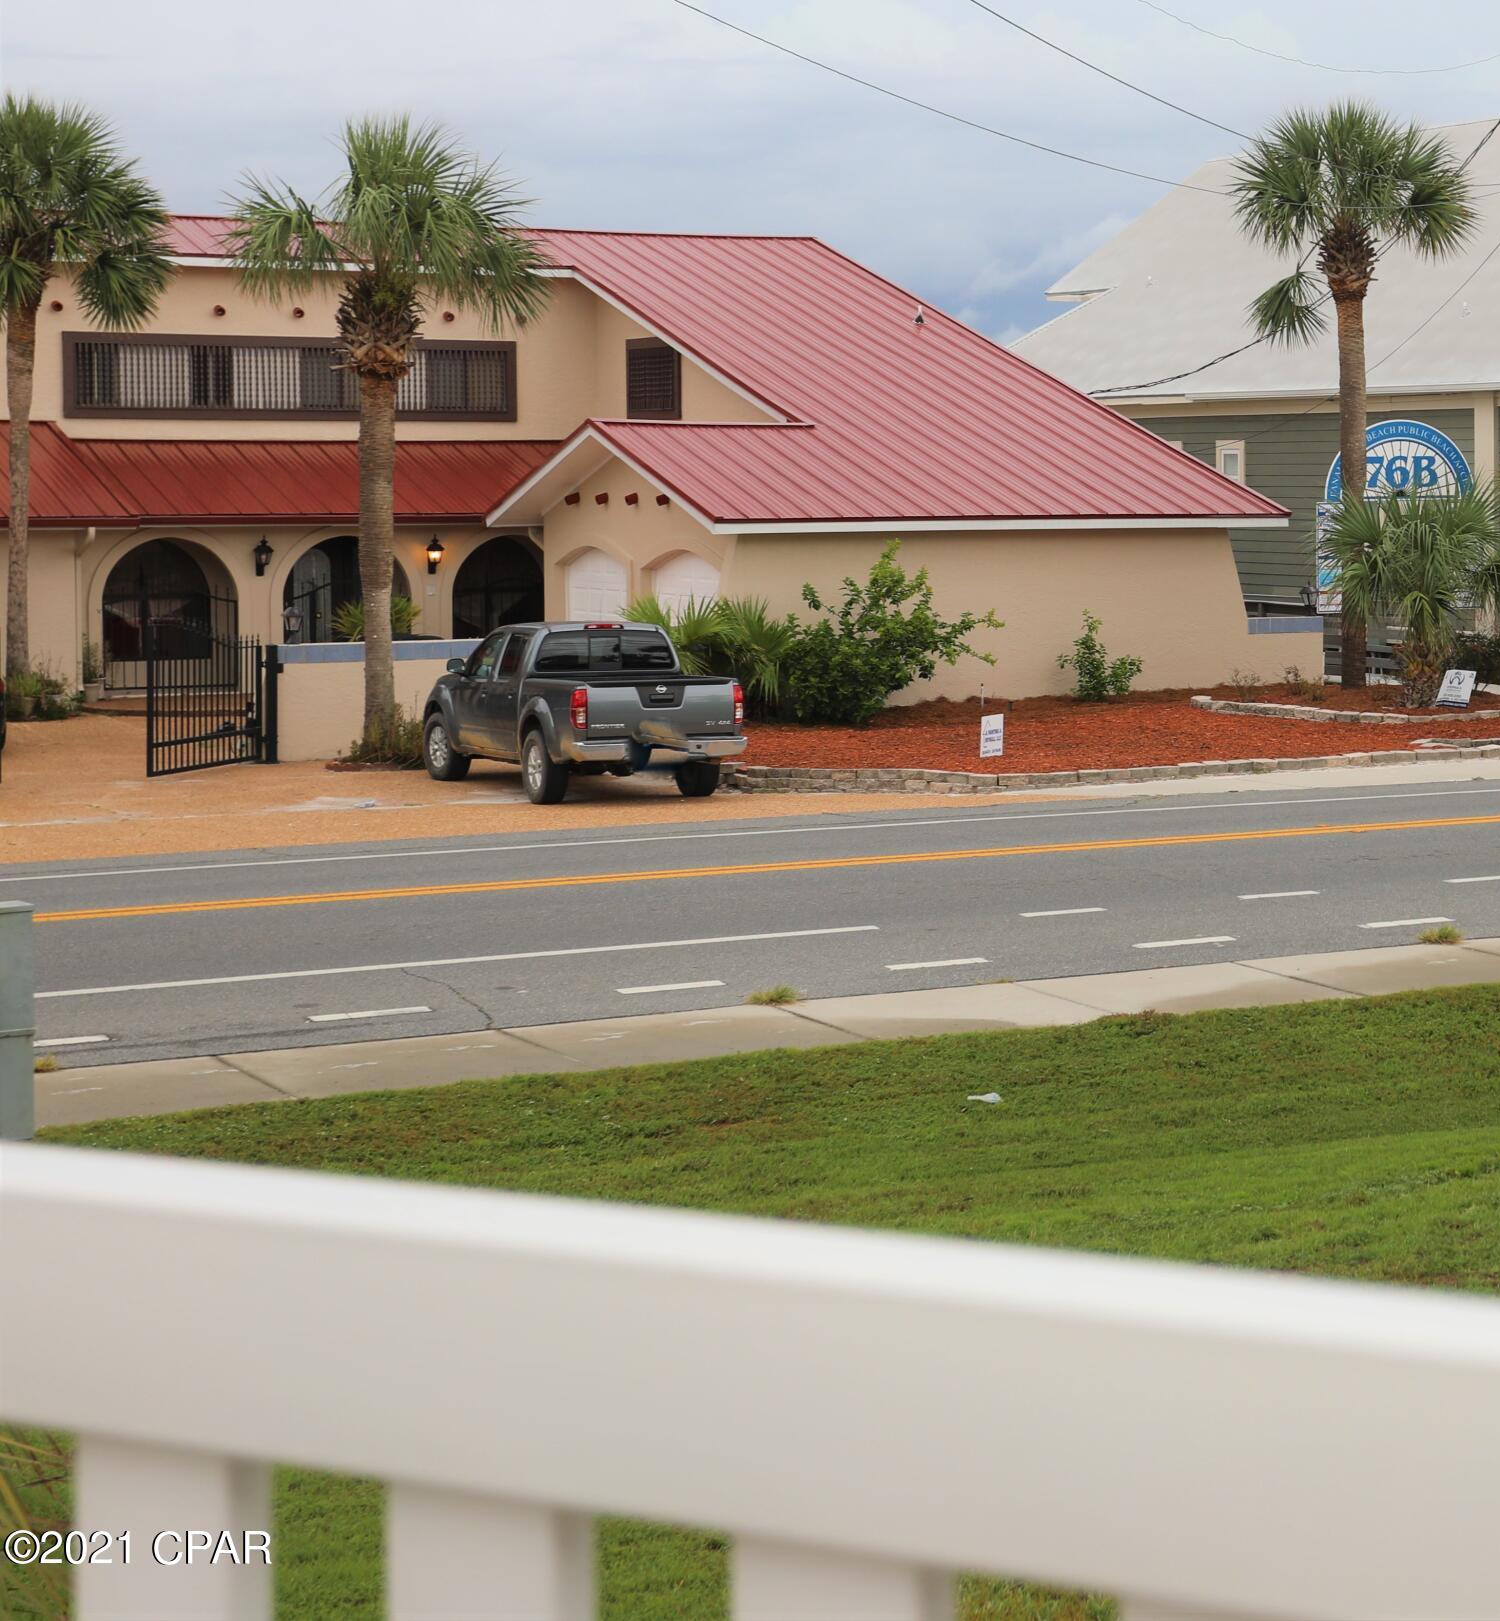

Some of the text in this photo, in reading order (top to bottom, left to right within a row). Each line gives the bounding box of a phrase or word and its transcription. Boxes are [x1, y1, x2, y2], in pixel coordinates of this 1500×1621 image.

[1366, 426, 1396, 442] BEACH
[1397, 425, 1431, 439] PUBLIC
[1431, 434, 1457, 460] BEACH
[1366, 456, 1438, 488] 76B
